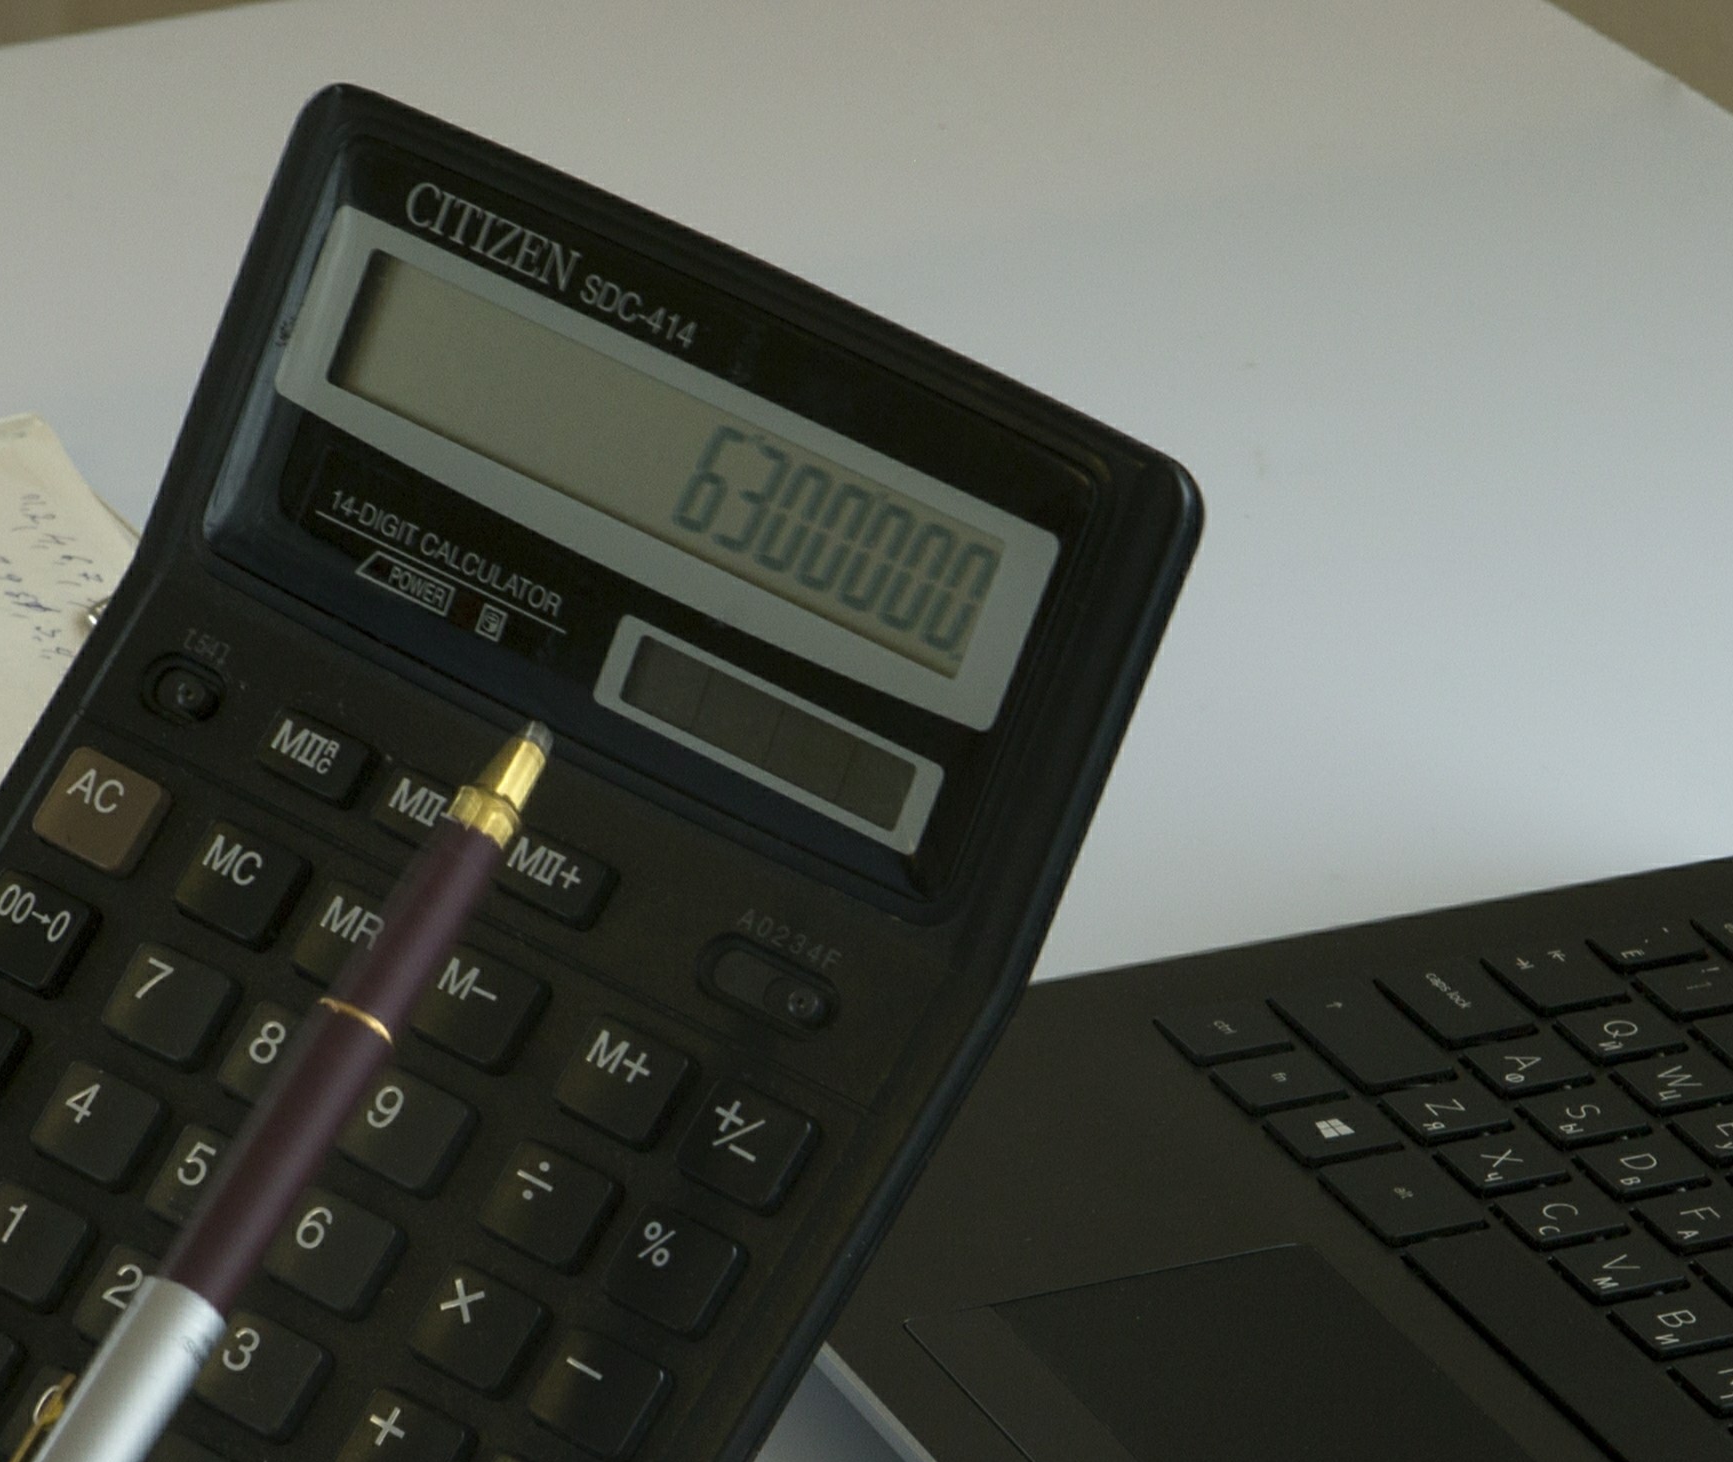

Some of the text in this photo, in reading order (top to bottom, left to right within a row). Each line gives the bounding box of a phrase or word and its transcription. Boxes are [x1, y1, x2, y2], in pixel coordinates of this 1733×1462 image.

[405, 182, 696, 350] CITIZEN SDC-414
[331, 490, 562, 616] 14-DIGIT CALCULATOR
[388, 566, 446, 607] POWER
[66, 768, 125, 814] AC
[202, 835, 263, 887] MC
[320, 896, 384, 949] MR
[134, 957, 174, 1000] 7
[1425, 972, 1472, 1010] caps lock
[249, 1021, 286, 1064] 8
[1603, 1020, 1639, 1040] Q
[586, 1031, 651, 1082] M+
[1504, 1055, 1542, 1072] A
[1657, 1065, 1703, 1088] W
[1505, 1073, 1525, 1084] Ф
[66, 1083, 102, 1125] 4
[367, 1086, 404, 1128] 9
[1424, 1098, 1466, 1117] Z
[1565, 1104, 1601, 1120] S
[1422, 1121, 1446, 1132] Я
[177, 1141, 217, 1187] 5
[1480, 1148, 1523, 1168] X
[1484, 1171, 1503, 1185] Ч
[1619, 1152, 1658, 1171] D
[0, 1203, 28, 1244] 1
[296, 1206, 333, 1249] 6
[1542, 1203, 1579, 1220] C
[1679, 1206, 1721, 1220] F
[638, 1221, 675, 1267] %
[1602, 1253, 1640, 1269] V
[101, 1264, 144, 1310] 2
[1656, 1309, 1697, 1328] B
[222, 1327, 260, 1371] 3
[1654, 1333, 1680, 1346] И
